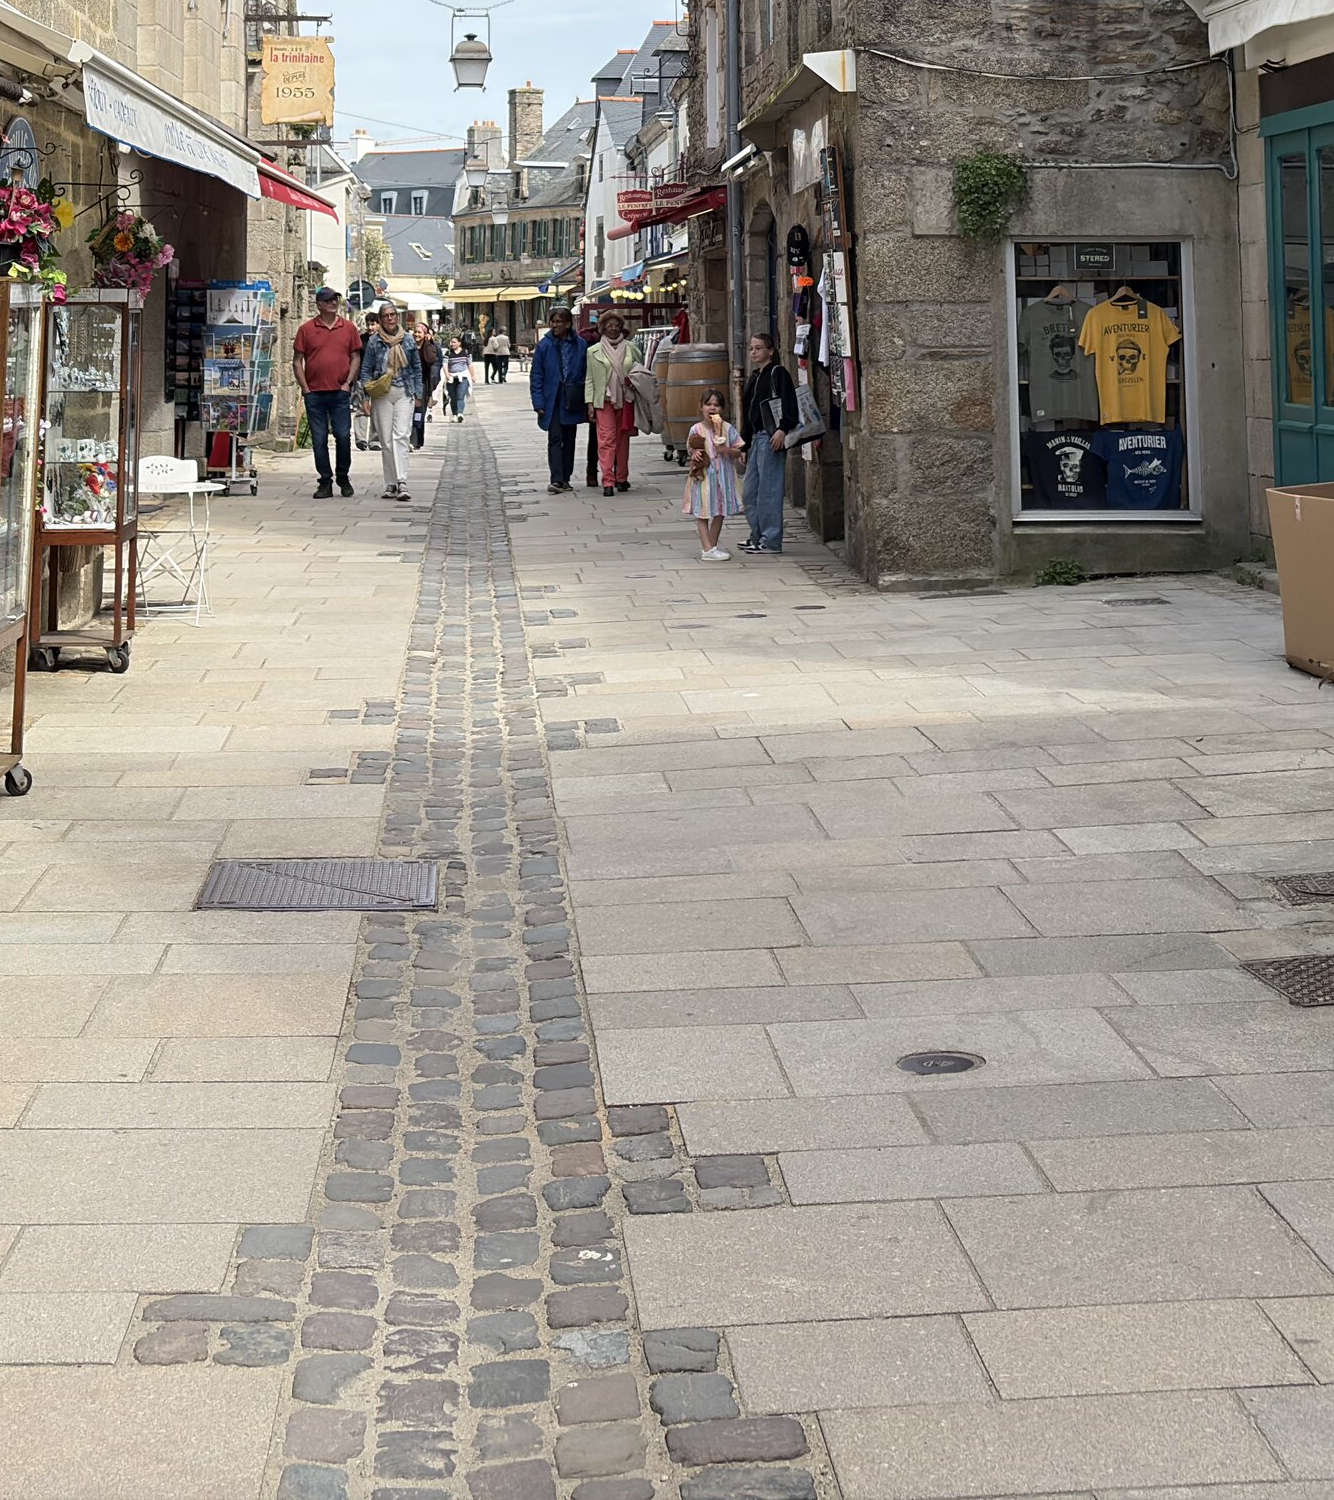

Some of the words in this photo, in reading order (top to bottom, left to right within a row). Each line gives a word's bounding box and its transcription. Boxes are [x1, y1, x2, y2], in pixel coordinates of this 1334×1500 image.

[270, 46, 279, 63] la
[282, 53, 325, 63] trinitaine
[283, 74, 306, 83] DEPUIS
[276, 87, 315, 99] 1955
[1103, 323, 1151, 336] AVENTURIER
[1119, 435, 1167, 452] AVENTURIER
